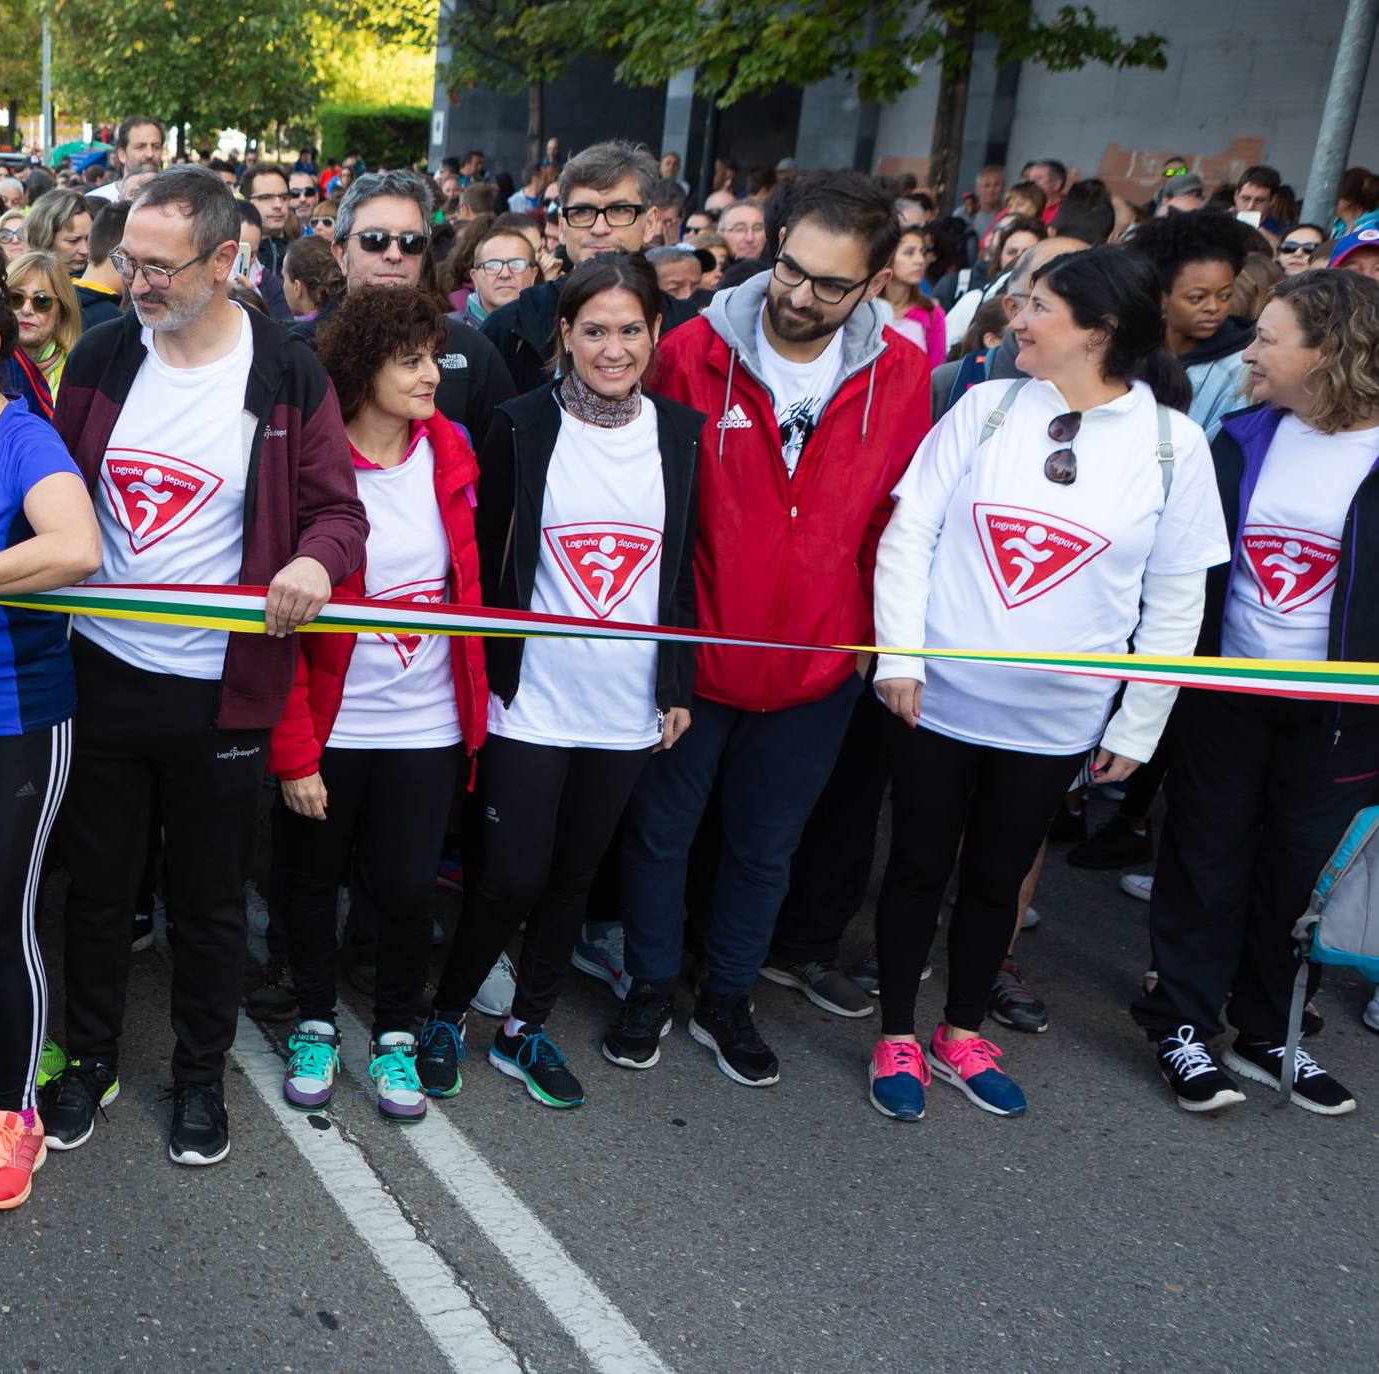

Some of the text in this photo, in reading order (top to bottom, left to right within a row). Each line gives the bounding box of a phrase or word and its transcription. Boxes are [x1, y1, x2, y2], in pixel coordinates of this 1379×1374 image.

[111, 464, 197, 492] Logroño deporte
[566, 537, 648, 552] Logroño deporte
[990, 518, 1083, 552] Logroño deporte
[1247, 539, 1336, 562] Logroño deporte
